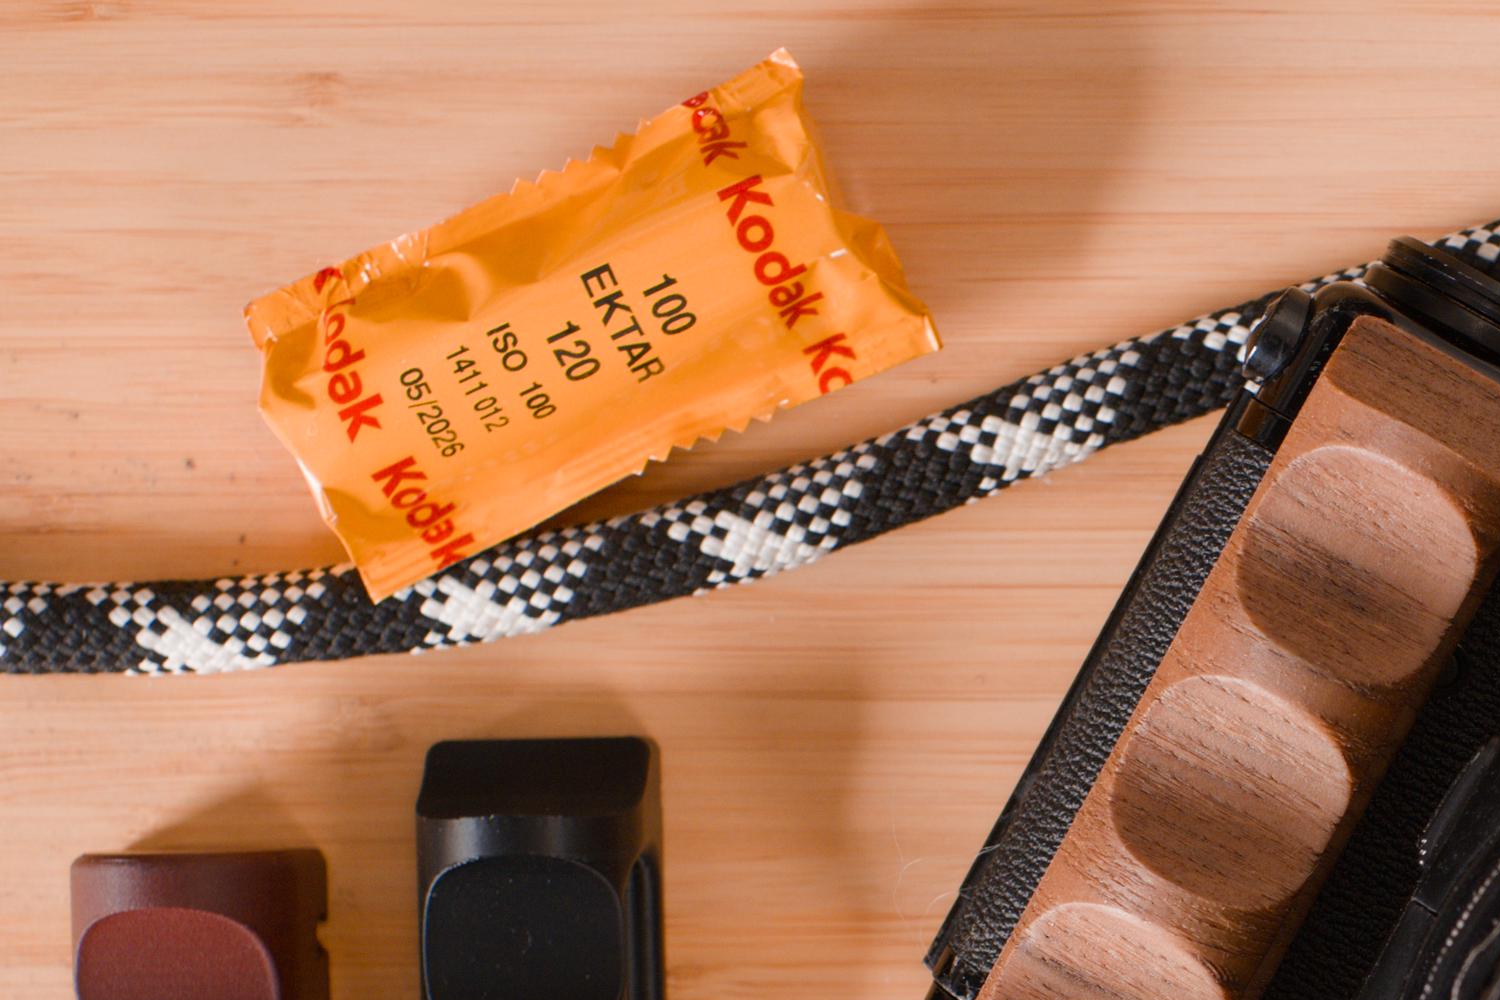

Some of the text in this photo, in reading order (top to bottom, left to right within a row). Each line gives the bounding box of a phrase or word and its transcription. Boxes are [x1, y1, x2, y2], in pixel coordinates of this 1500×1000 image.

[716, 174, 824, 331] Kodak
[546, 320, 601, 382] 120
[580, 262, 665, 384] EKTAR
[643, 273, 697, 336] 100
[399, 367, 465, 458] 05/2026
[446, 345, 510, 433] 1411 012
[486, 322, 557, 420] ISO 100
[371, 455, 475, 570] Kodak
